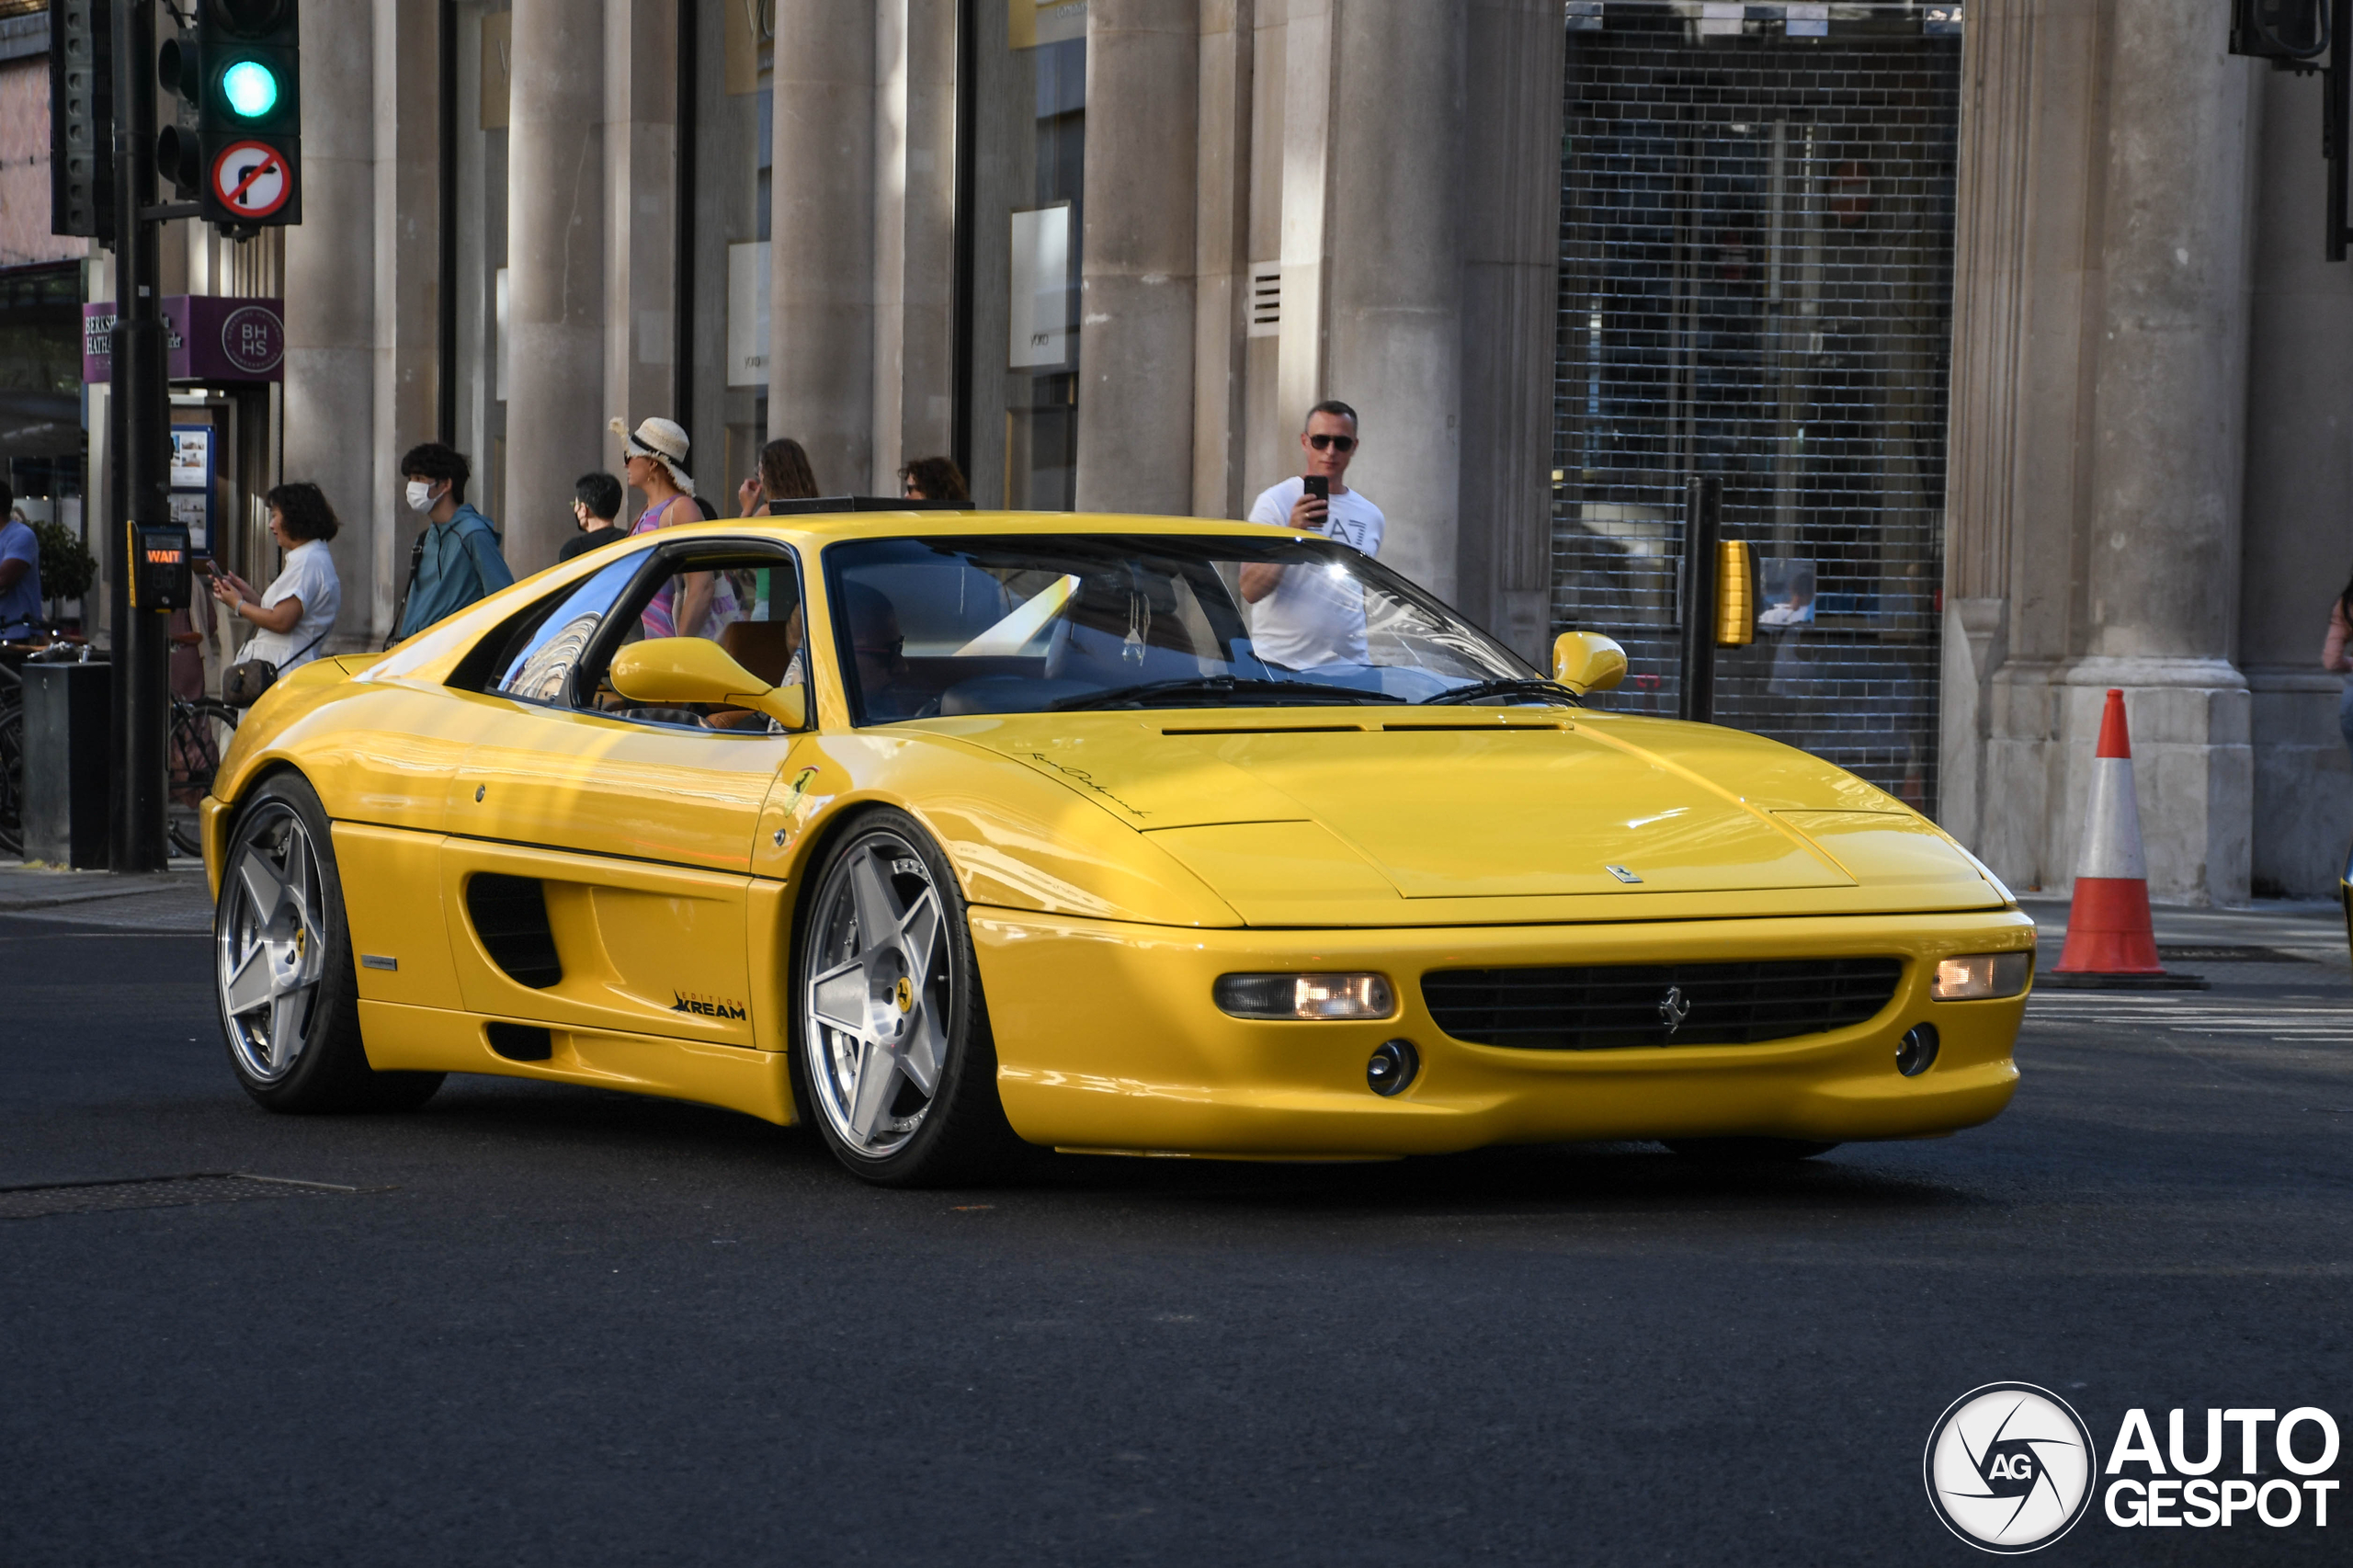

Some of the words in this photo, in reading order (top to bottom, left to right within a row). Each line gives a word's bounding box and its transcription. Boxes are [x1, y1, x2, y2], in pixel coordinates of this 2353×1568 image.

[242, 323, 267, 339] BH
[242, 339, 267, 357] HS
[1306, 517, 1367, 546] A7
[147, 550, 180, 563] WAIT
[681, 991, 743, 1008] EDITION
